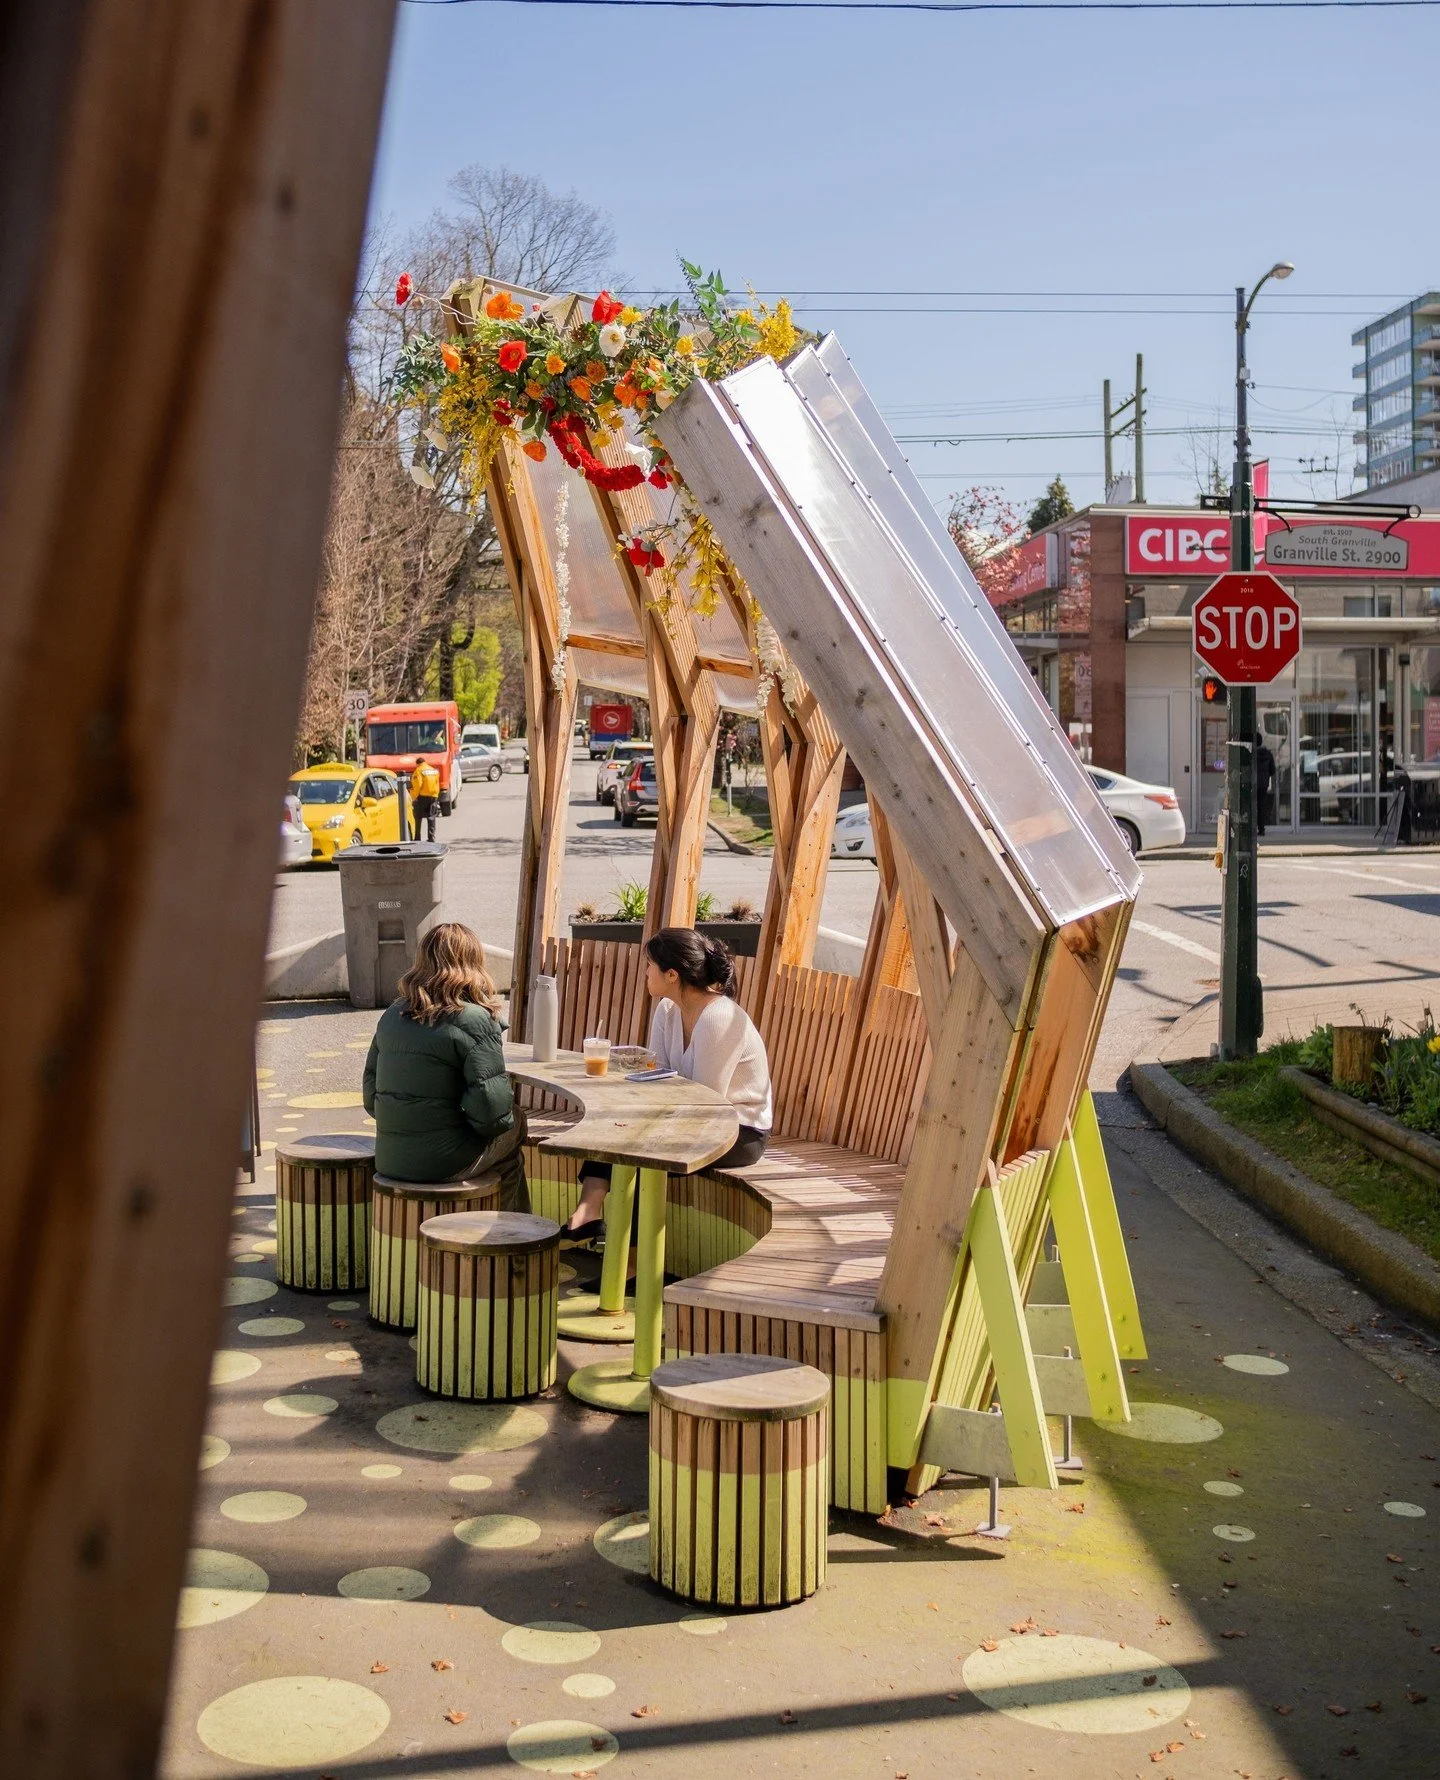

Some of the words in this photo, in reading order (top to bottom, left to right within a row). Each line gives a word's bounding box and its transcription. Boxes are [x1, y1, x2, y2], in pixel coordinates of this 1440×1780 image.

[1138, 528, 1228, 563] CIBC
[1298, 535, 1329, 546] South
[1331, 537, 1377, 548] Granville
[1273, 545, 1338, 562] Granville
[1341, 548, 1361, 562] St.
[1365, 551, 1401, 564] 2900
[1198, 605, 1297, 650] STOP
[348, 698, 366, 711] 30
